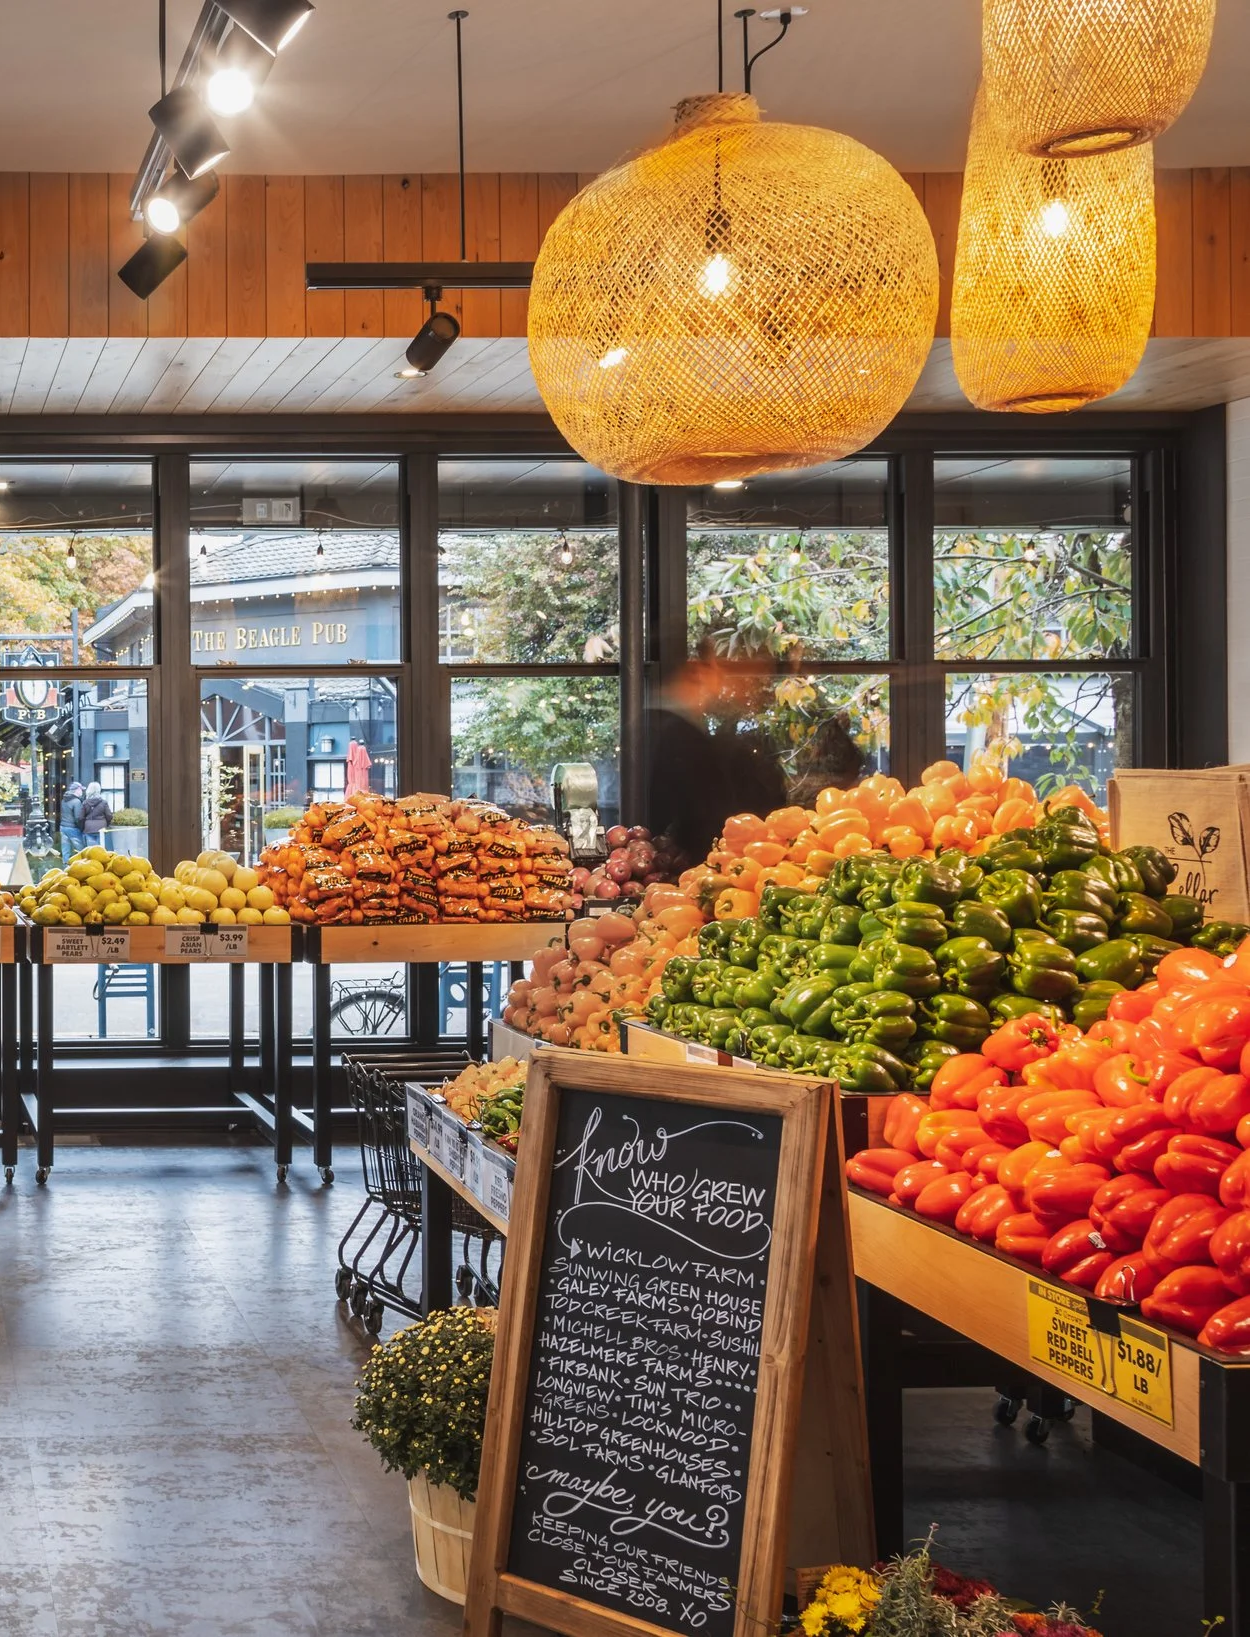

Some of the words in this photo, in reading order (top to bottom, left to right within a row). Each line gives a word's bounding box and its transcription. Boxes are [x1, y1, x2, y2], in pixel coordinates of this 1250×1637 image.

[192, 630, 226, 652] THE
[234, 626, 301, 650] BEAGLE
[312, 622, 347, 645] PUB
[1164, 847, 1175, 855] THE
[493, 888, 520, 896] Citrus
[543, 874, 569, 887] Citrus
[1172, 863, 1218, 904] ellar
[398, 912, 424, 923] Citrus
[101, 937, 125, 945] $2.49
[106, 946, 119, 954] /LB
[219, 933, 243, 942] $3.99
[554, 1106, 668, 1204] know
[631, 1168, 686, 1194] WHO
[692, 1179, 766, 1207] GREW
[627, 1187, 685, 1220] YOUR
[691, 1203, 764, 1233] FOOD
[548, 1257, 640, 1290] SUNWING
[645, 1276, 700, 1301] GREEN
[705, 1289, 762, 1317] HOUSE
[692, 1261, 755, 1289] FARM
[557, 1276, 610, 1297] GALEY
[612, 1287, 682, 1315] FARMS
[1038, 1285, 1047, 1297] IN
[1047, 1289, 1071, 1308] STORE
[553, 1315, 628, 1345] MICHELL
[630, 1336, 682, 1361] BROS
[691, 1349, 750, 1380] HENRY
[648, 1318, 701, 1343] FARM
[1046, 1331, 1067, 1351] RED
[1070, 1341, 1095, 1365] BELL
[1051, 1317, 1088, 1344] SWEET
[538, 1331, 638, 1367] HAZELMERE
[641, 1358, 712, 1388] FARMS
[1049, 1347, 1094, 1381] PEPPERS
[1117, 1339, 1162, 1378] $1.88/
[536, 1371, 615, 1403] LONGVIEW
[625, 1394, 672, 1416] TIM'S
[547, 1356, 624, 1389] FIRBANK
[634, 1375, 666, 1399] SUN
[671, 1387, 721, 1410] TRIO
[1133, 1374, 1149, 1395] LB
[531, 1406, 599, 1436] HILLTOP
[599, 1427, 731, 1479] GREENHOUSES
[622, 1410, 729, 1453] LOCKWOOD
[537, 1428, 580, 1451] SOL
[582, 1443, 645, 1472] FARMS
[655, 1464, 742, 1506] GLANFORD
[526, 1466, 636, 1517] maybe
[532, 1511, 608, 1552] KEEPING
[613, 1542, 648, 1564] OUR
[650, 1553, 731, 1590] FRIENDS
[528, 1529, 586, 1556] CLOSE
[642, 1566, 731, 1612] FARMERS
[573, 1558, 661, 1600] CLOSER
[559, 1569, 622, 1597] SINCE
[680, 1602, 708, 1628] XO
